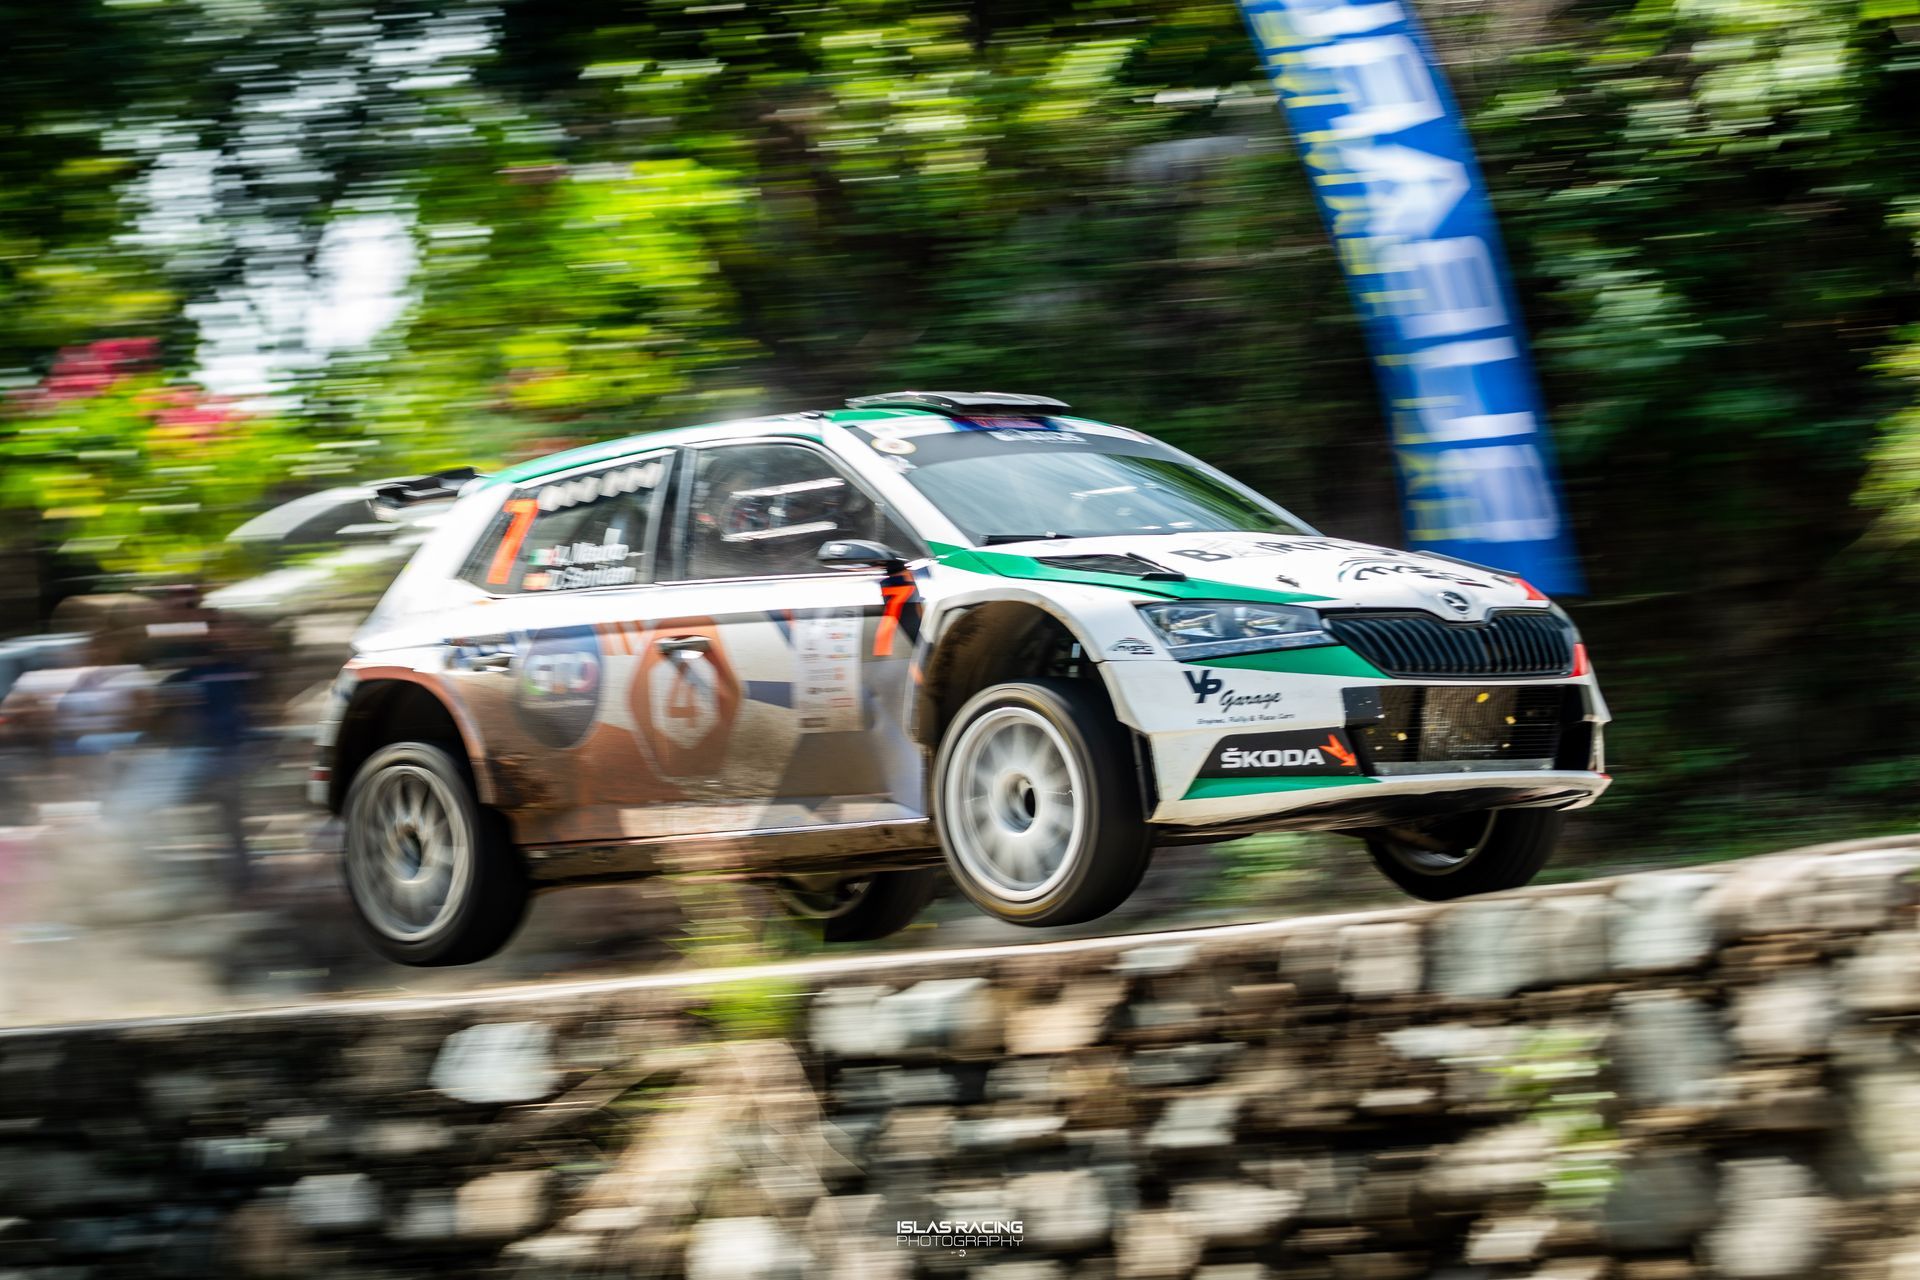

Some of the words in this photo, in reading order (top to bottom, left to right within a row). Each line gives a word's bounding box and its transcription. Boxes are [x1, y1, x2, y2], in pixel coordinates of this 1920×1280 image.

[872, 585, 916, 656] 7
[1182, 669, 1223, 704] VP
[1219, 689, 1282, 714] Garage
[1220, 747, 1326, 769] ŠKODA
